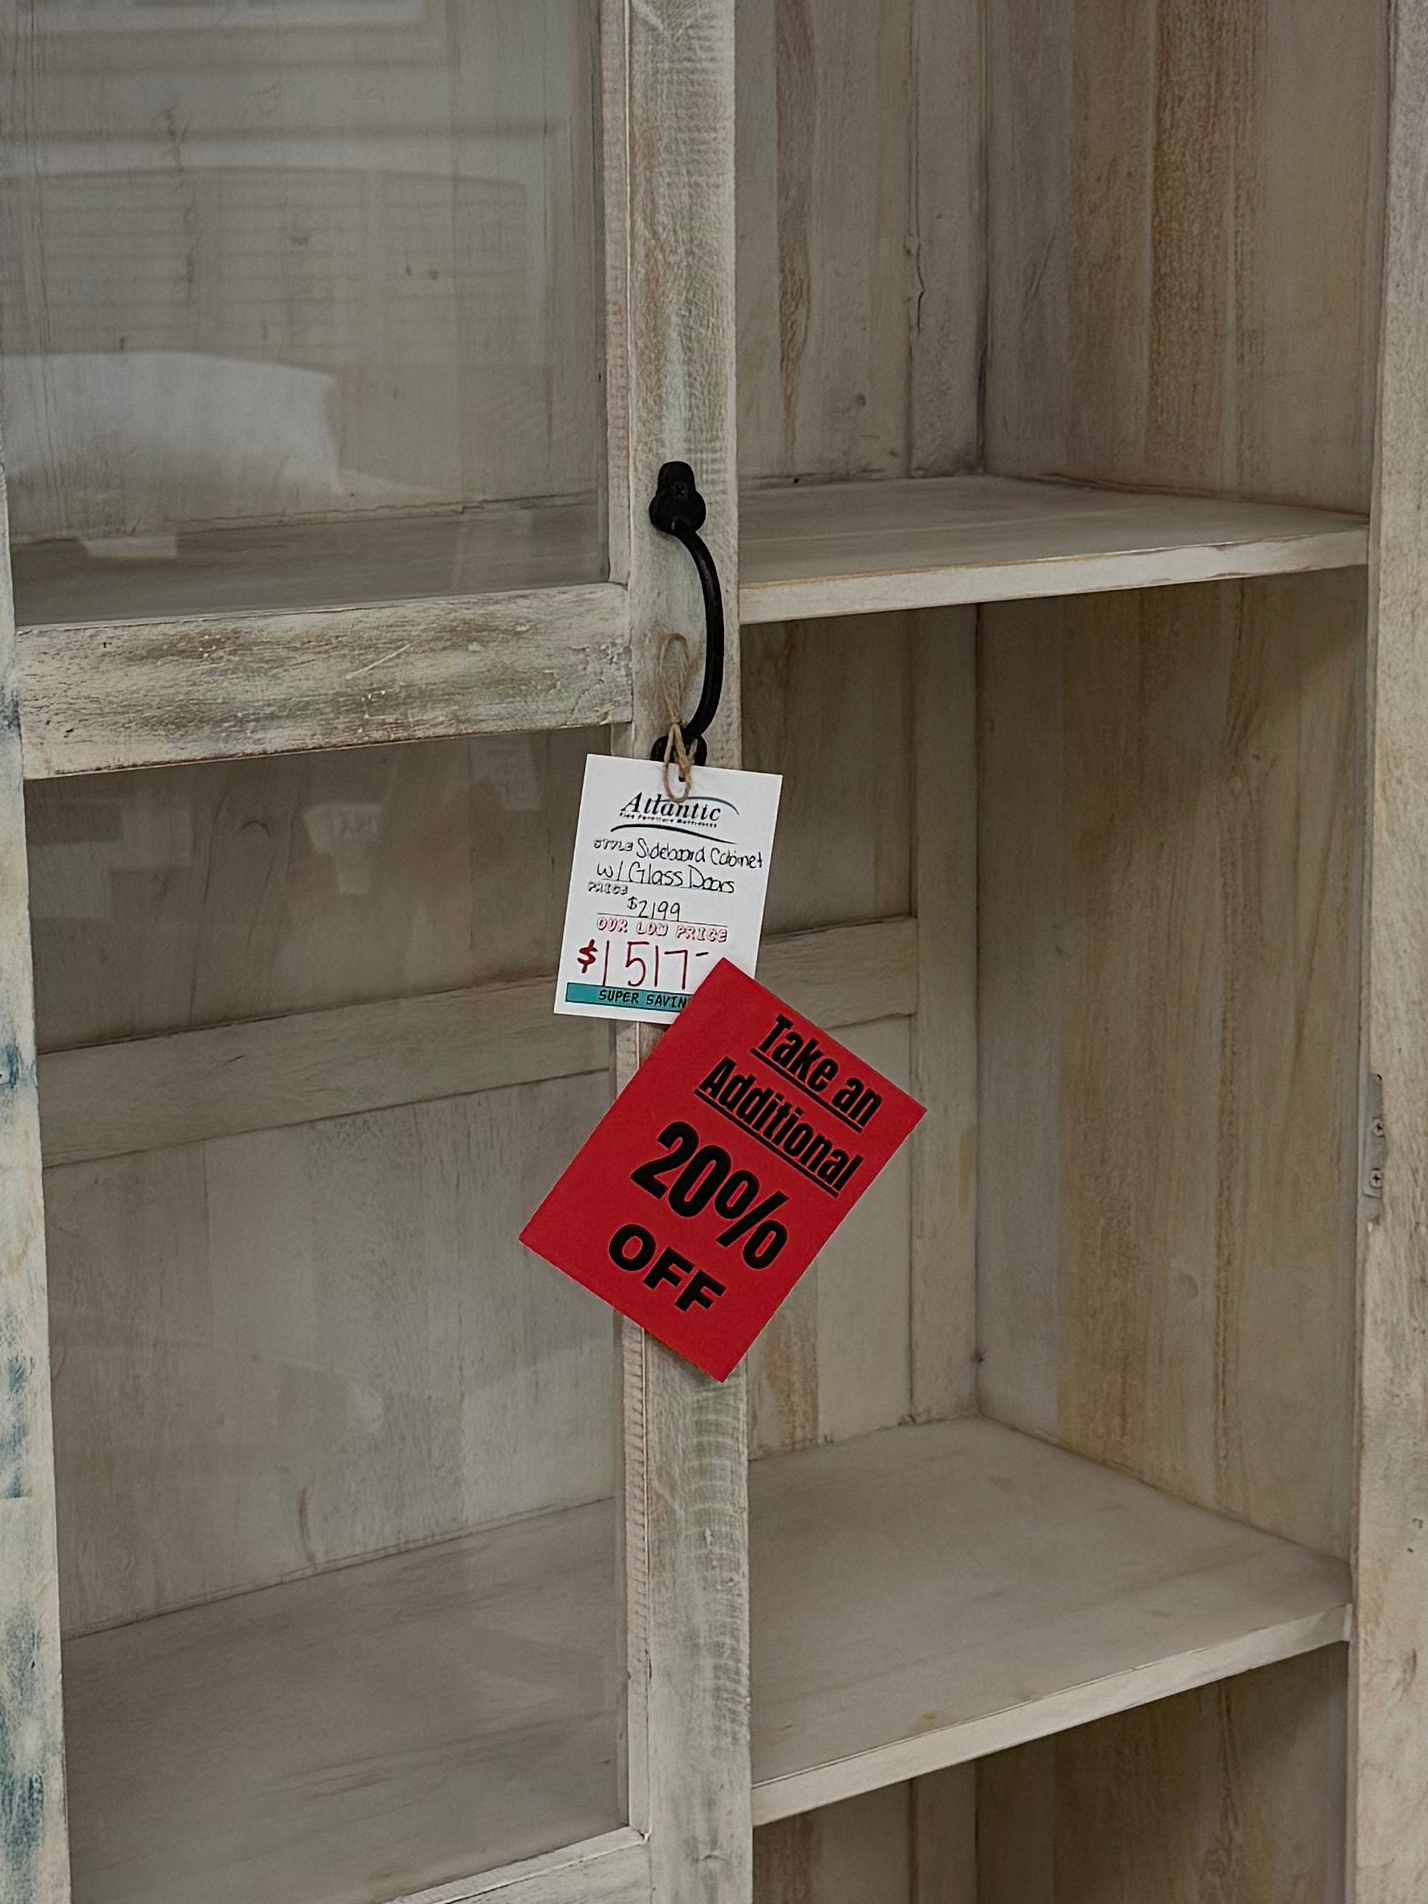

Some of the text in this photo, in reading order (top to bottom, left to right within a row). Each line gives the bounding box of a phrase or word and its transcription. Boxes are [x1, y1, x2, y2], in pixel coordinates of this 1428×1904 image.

[620, 791, 722, 822] Atlantic
[636, 837, 706, 864] Sideboard
[710, 846, 764, 869] Cabinet
[596, 860, 735, 894] w/ Glass Doors
[627, 896, 681, 922] $2199
[596, 916, 728, 943] OUR LOW PRICE
[598, 989, 688, 1009] SUPER SAVIN
[757, 1013, 883, 1128] Take an
[697, 1055, 864, 1191] Additional
[629, 1120, 790, 1270] 20%
[608, 1223, 727, 1312] OFF
